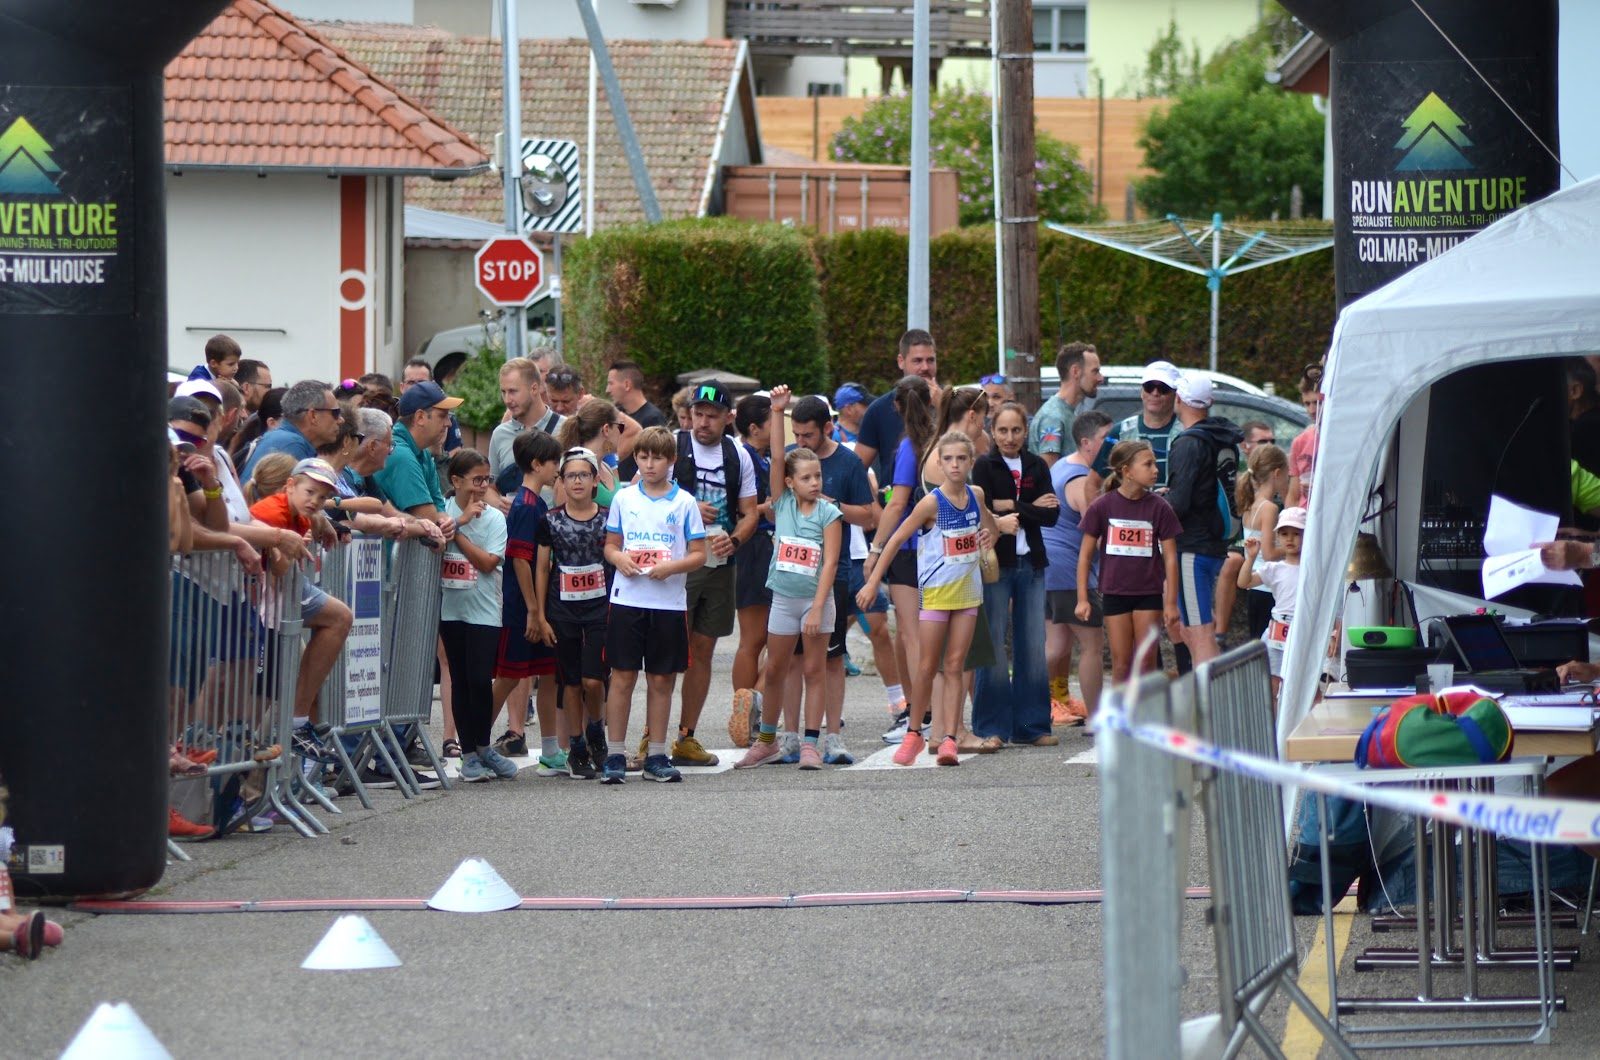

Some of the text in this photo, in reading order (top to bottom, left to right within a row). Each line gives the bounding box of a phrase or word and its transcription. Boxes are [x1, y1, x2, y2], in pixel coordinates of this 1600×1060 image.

[1351, 176, 1527, 213] RUNAVENTURE
[483, 260, 536, 281] STOP
[627, 531, 677, 543] CMA CGM
[1119, 529, 1141, 542] 621
[956, 536, 975, 550] 686
[785, 546, 808, 561] 613
[444, 562, 465, 576] 706
[572, 574, 594, 587] 616
